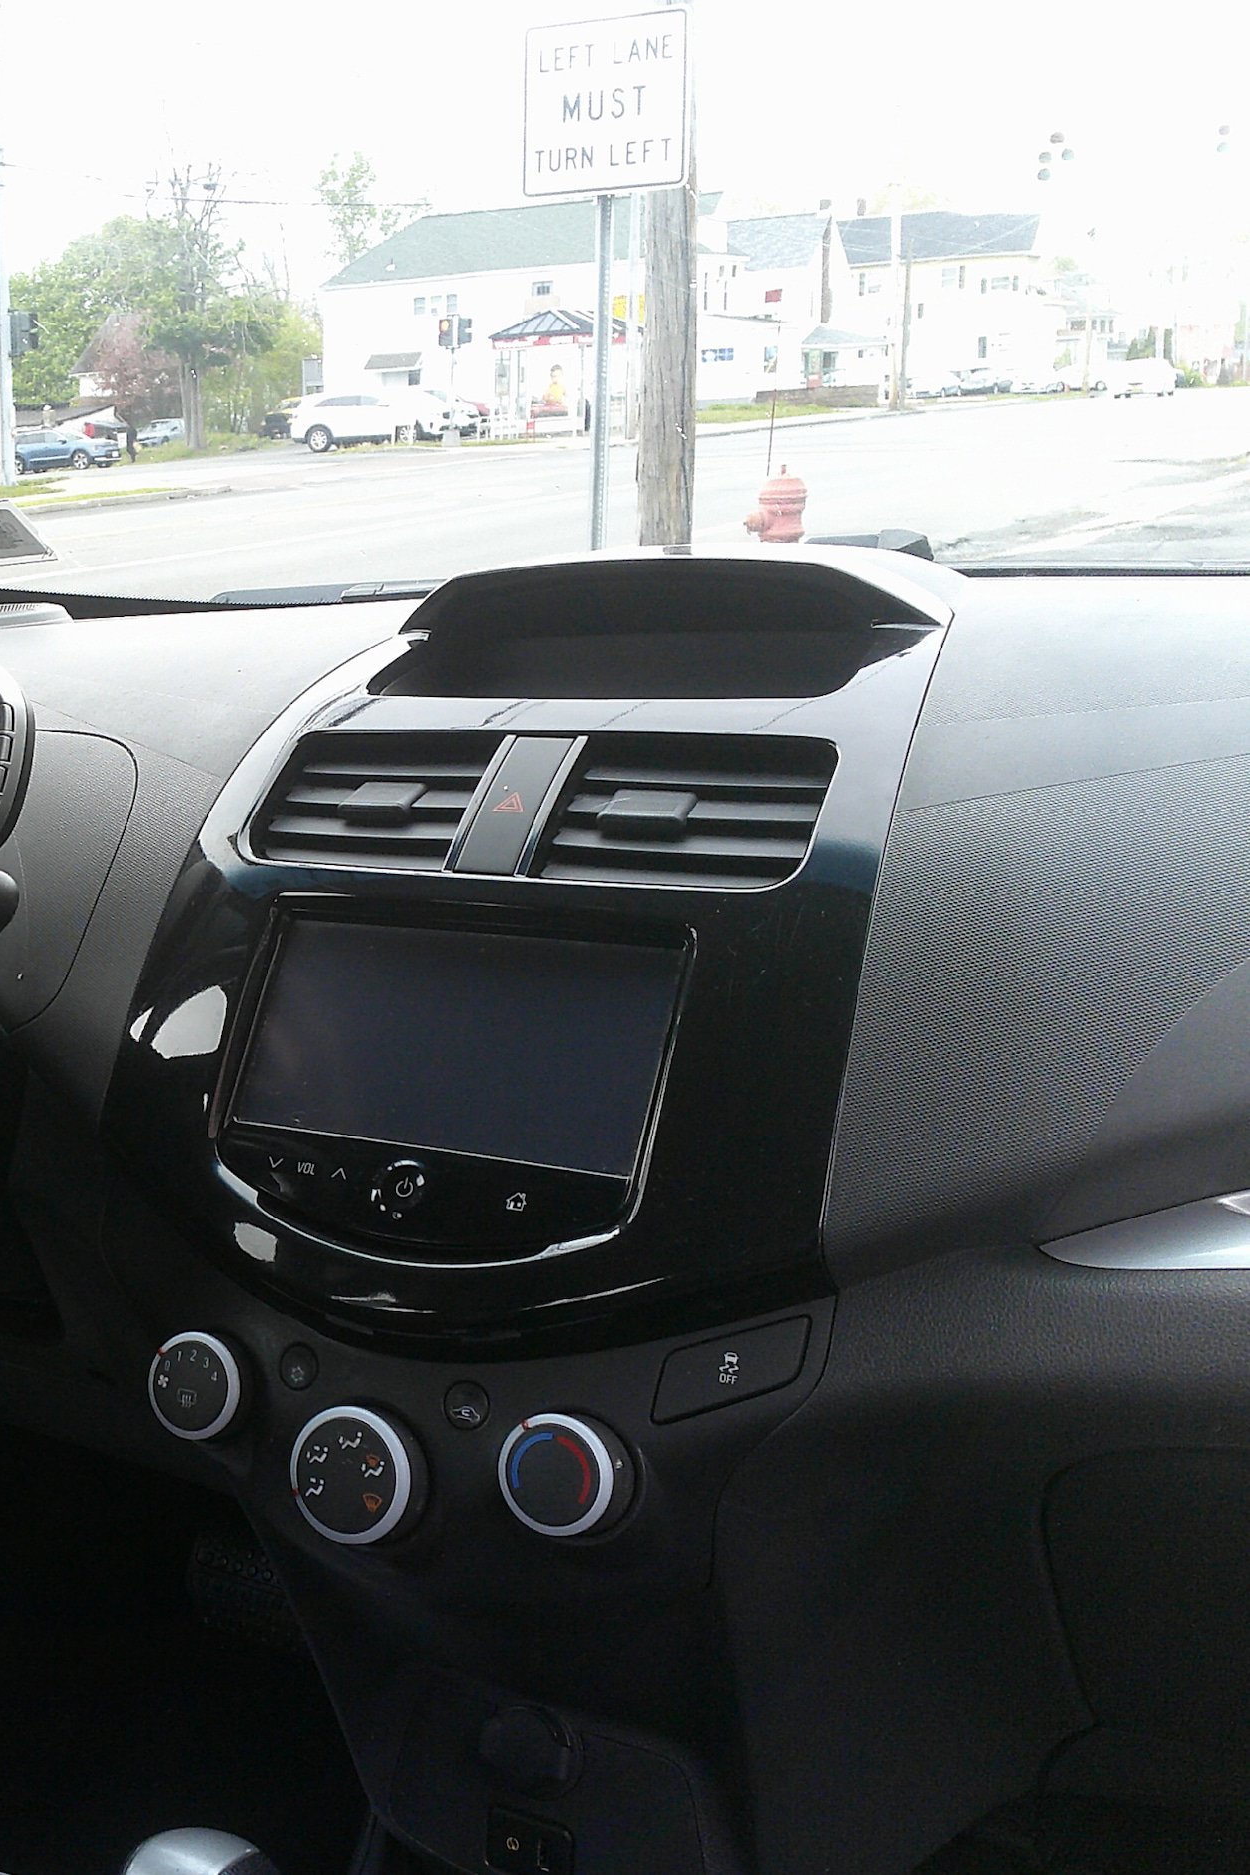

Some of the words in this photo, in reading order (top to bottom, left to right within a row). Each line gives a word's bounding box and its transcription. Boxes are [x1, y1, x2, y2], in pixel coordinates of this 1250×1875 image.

[539, 44, 594, 73] LEFT
[613, 34, 673, 64] LANE
[562, 85, 646, 124] MUST
[534, 145, 594, 173] TURN
[609, 138, 672, 167] LEFT
[297, 1161, 315, 1176] VOL
[190, 1349, 198, 1362] 2
[203, 1356, 210, 1369] 3
[718, 1372, 739, 1385] OFF
